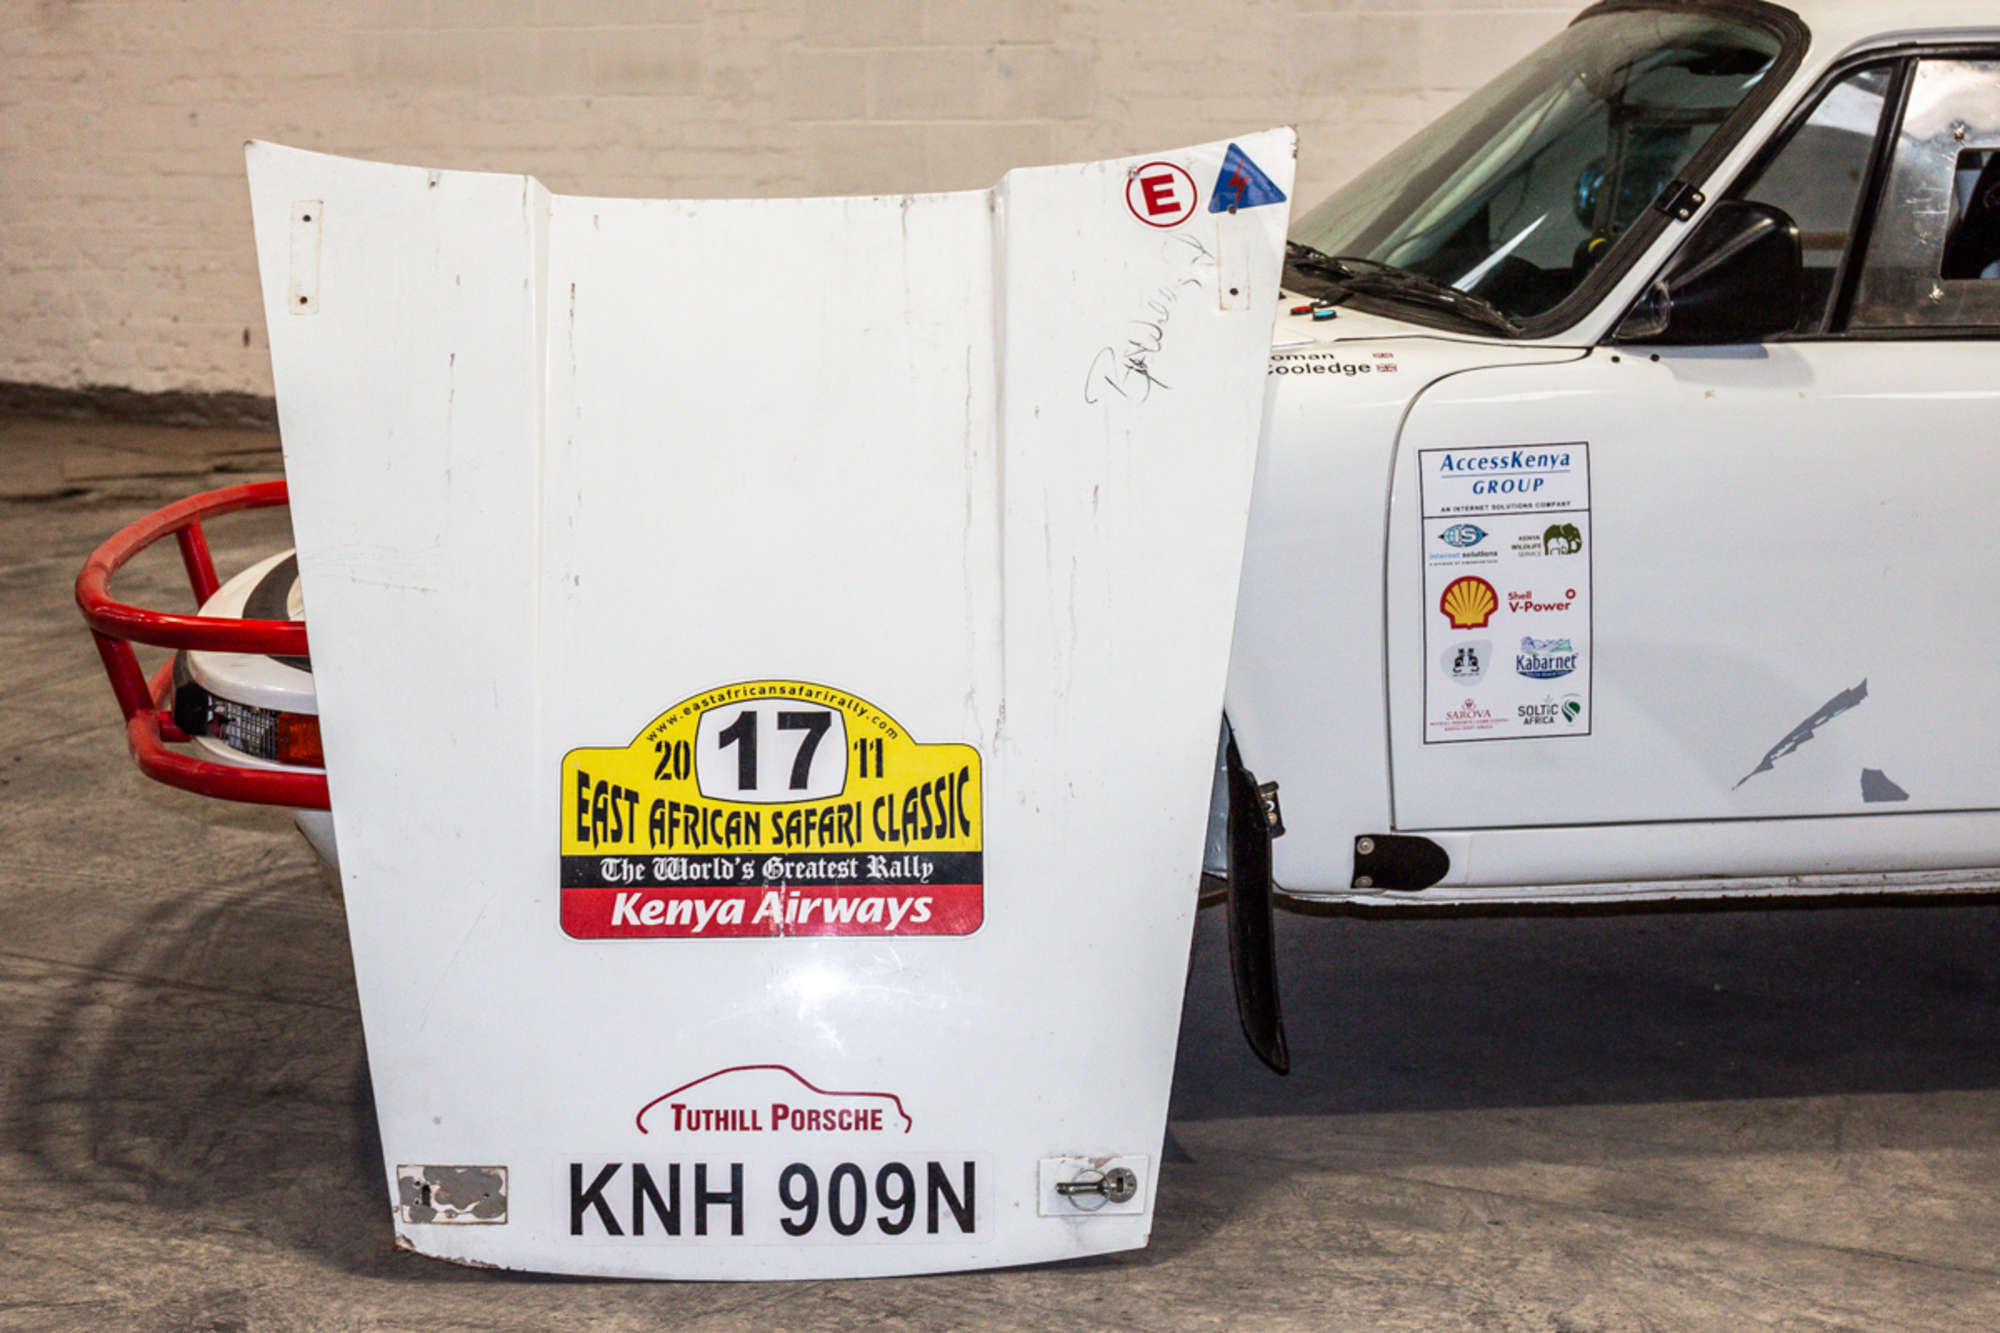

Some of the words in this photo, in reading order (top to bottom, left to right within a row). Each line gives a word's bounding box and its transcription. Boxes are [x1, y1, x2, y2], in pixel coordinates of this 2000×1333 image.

[1140, 173, 1182, 216] E
[1440, 450, 1571, 472] AccessKenya
[1472, 477, 1544, 495] GROUP
[1508, 590, 1532, 600] Shell
[1508, 600, 1570, 613] V-Power
[1516, 653, 1576, 670] Kabarnet
[646, 683, 899, 742] www.eastafricansafarirally.com
[1446, 708, 1491, 720] SAROVA
[1523, 716, 1554, 725] AFRICA
[718, 710, 832, 790] 17
[577, 769, 640, 849] EAST
[650, 798, 761, 849] AFRICAN
[771, 801, 862, 849] SAFARI
[873, 765, 971, 848] CLASSIC
[600, 857, 646, 885] The
[652, 856, 756, 882] World's
[762, 856, 859, 881] Greatest
[866, 855, 934, 884] Rally
[611, 892, 746, 933] Kenya
[752, 889, 933, 931] Airways
[671, 1103, 763, 1132] TUTHILL
[771, 1103, 883, 1132] PORSCHE
[570, 1162, 744, 1236] KNH
[778, 1161, 976, 1237] 909N
